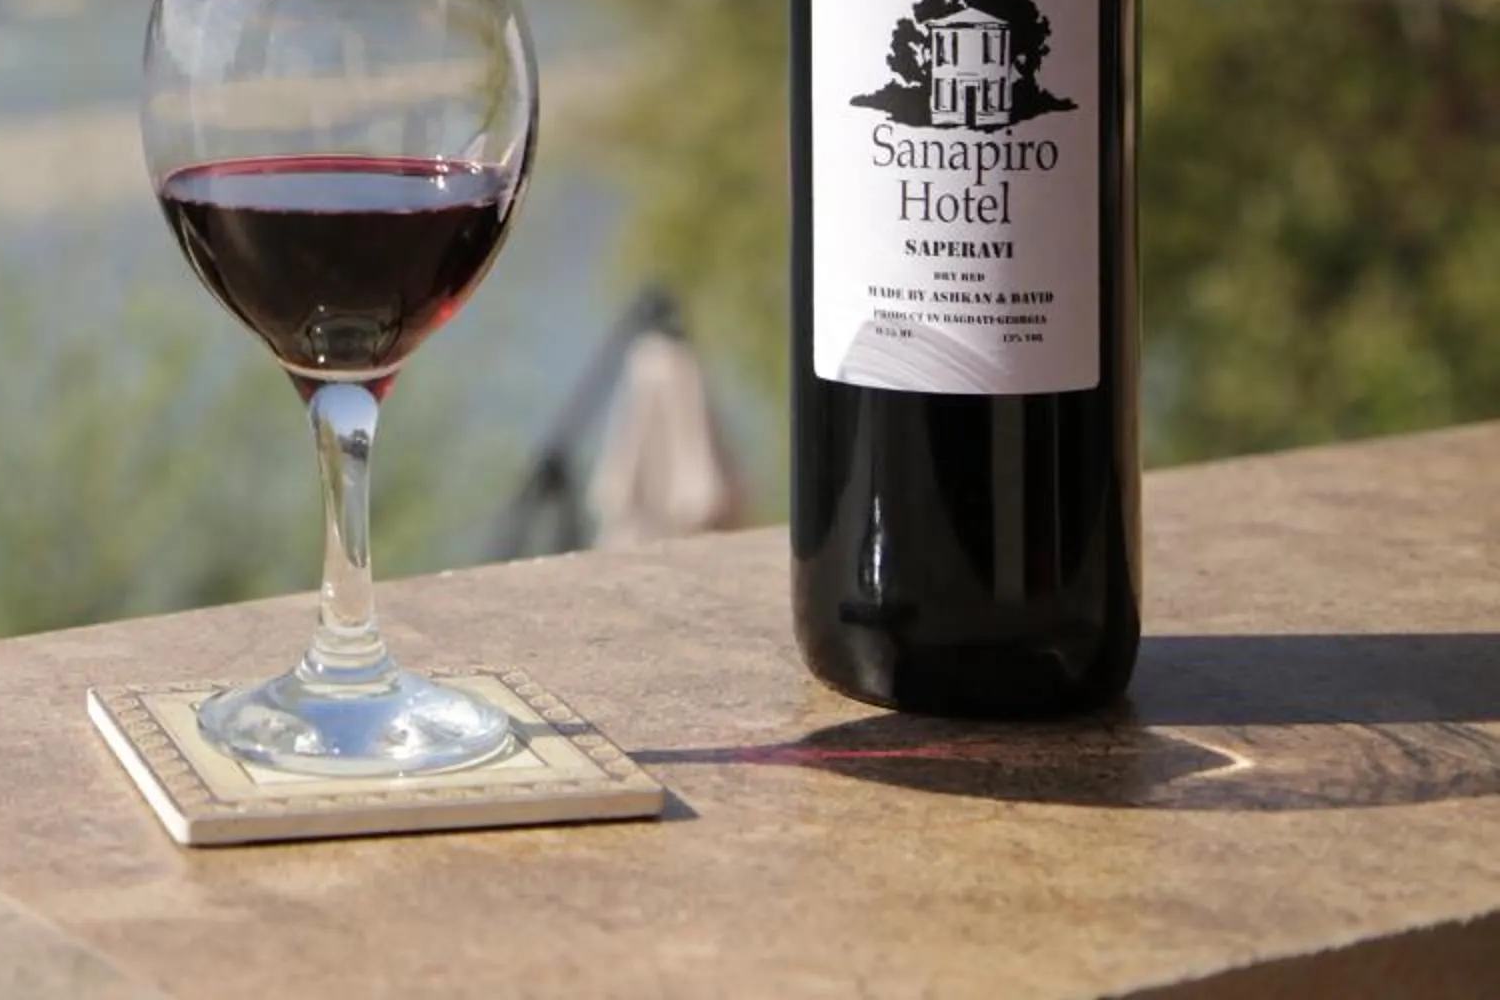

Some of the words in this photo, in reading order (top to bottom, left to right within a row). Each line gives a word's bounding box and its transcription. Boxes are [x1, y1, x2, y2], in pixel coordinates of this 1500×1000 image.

[872, 124, 1059, 186] Sanapiro
[898, 179, 1012, 224] Hotel
[904, 239, 1014, 259] SAPERAVI
[961, 271, 985, 283] RED
[868, 286, 904, 300] MADE
[907, 288, 926, 301] BY
[930, 291, 992, 304] ASHKAN
[995, 291, 1006, 304] &
[1011, 291, 1055, 304] DAVID
